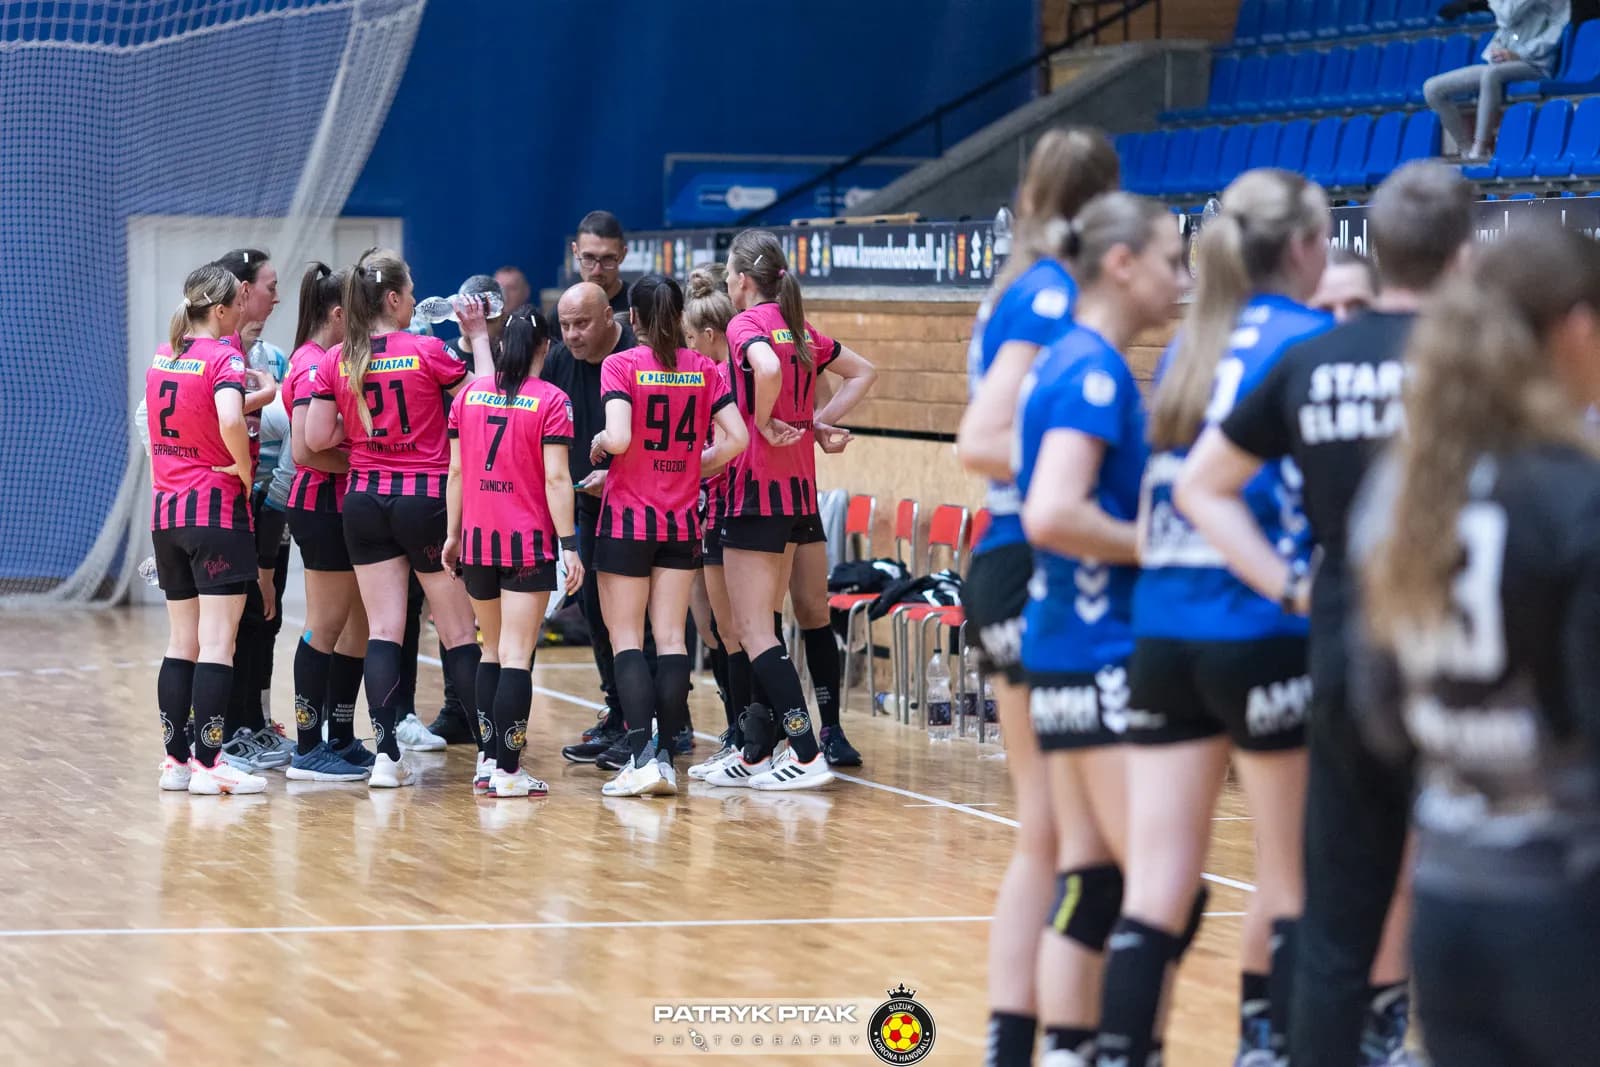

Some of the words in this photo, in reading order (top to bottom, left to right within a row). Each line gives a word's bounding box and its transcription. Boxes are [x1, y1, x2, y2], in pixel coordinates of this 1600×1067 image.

[368, 358, 414, 371] WIATAN
[654, 372, 702, 385] LEWIATAN
[1308, 360, 1408, 402] STAR
[159, 380, 180, 439] 2
[362, 379, 412, 437] 21
[644, 394, 697, 452] 94
[484, 415, 508, 471] 7
